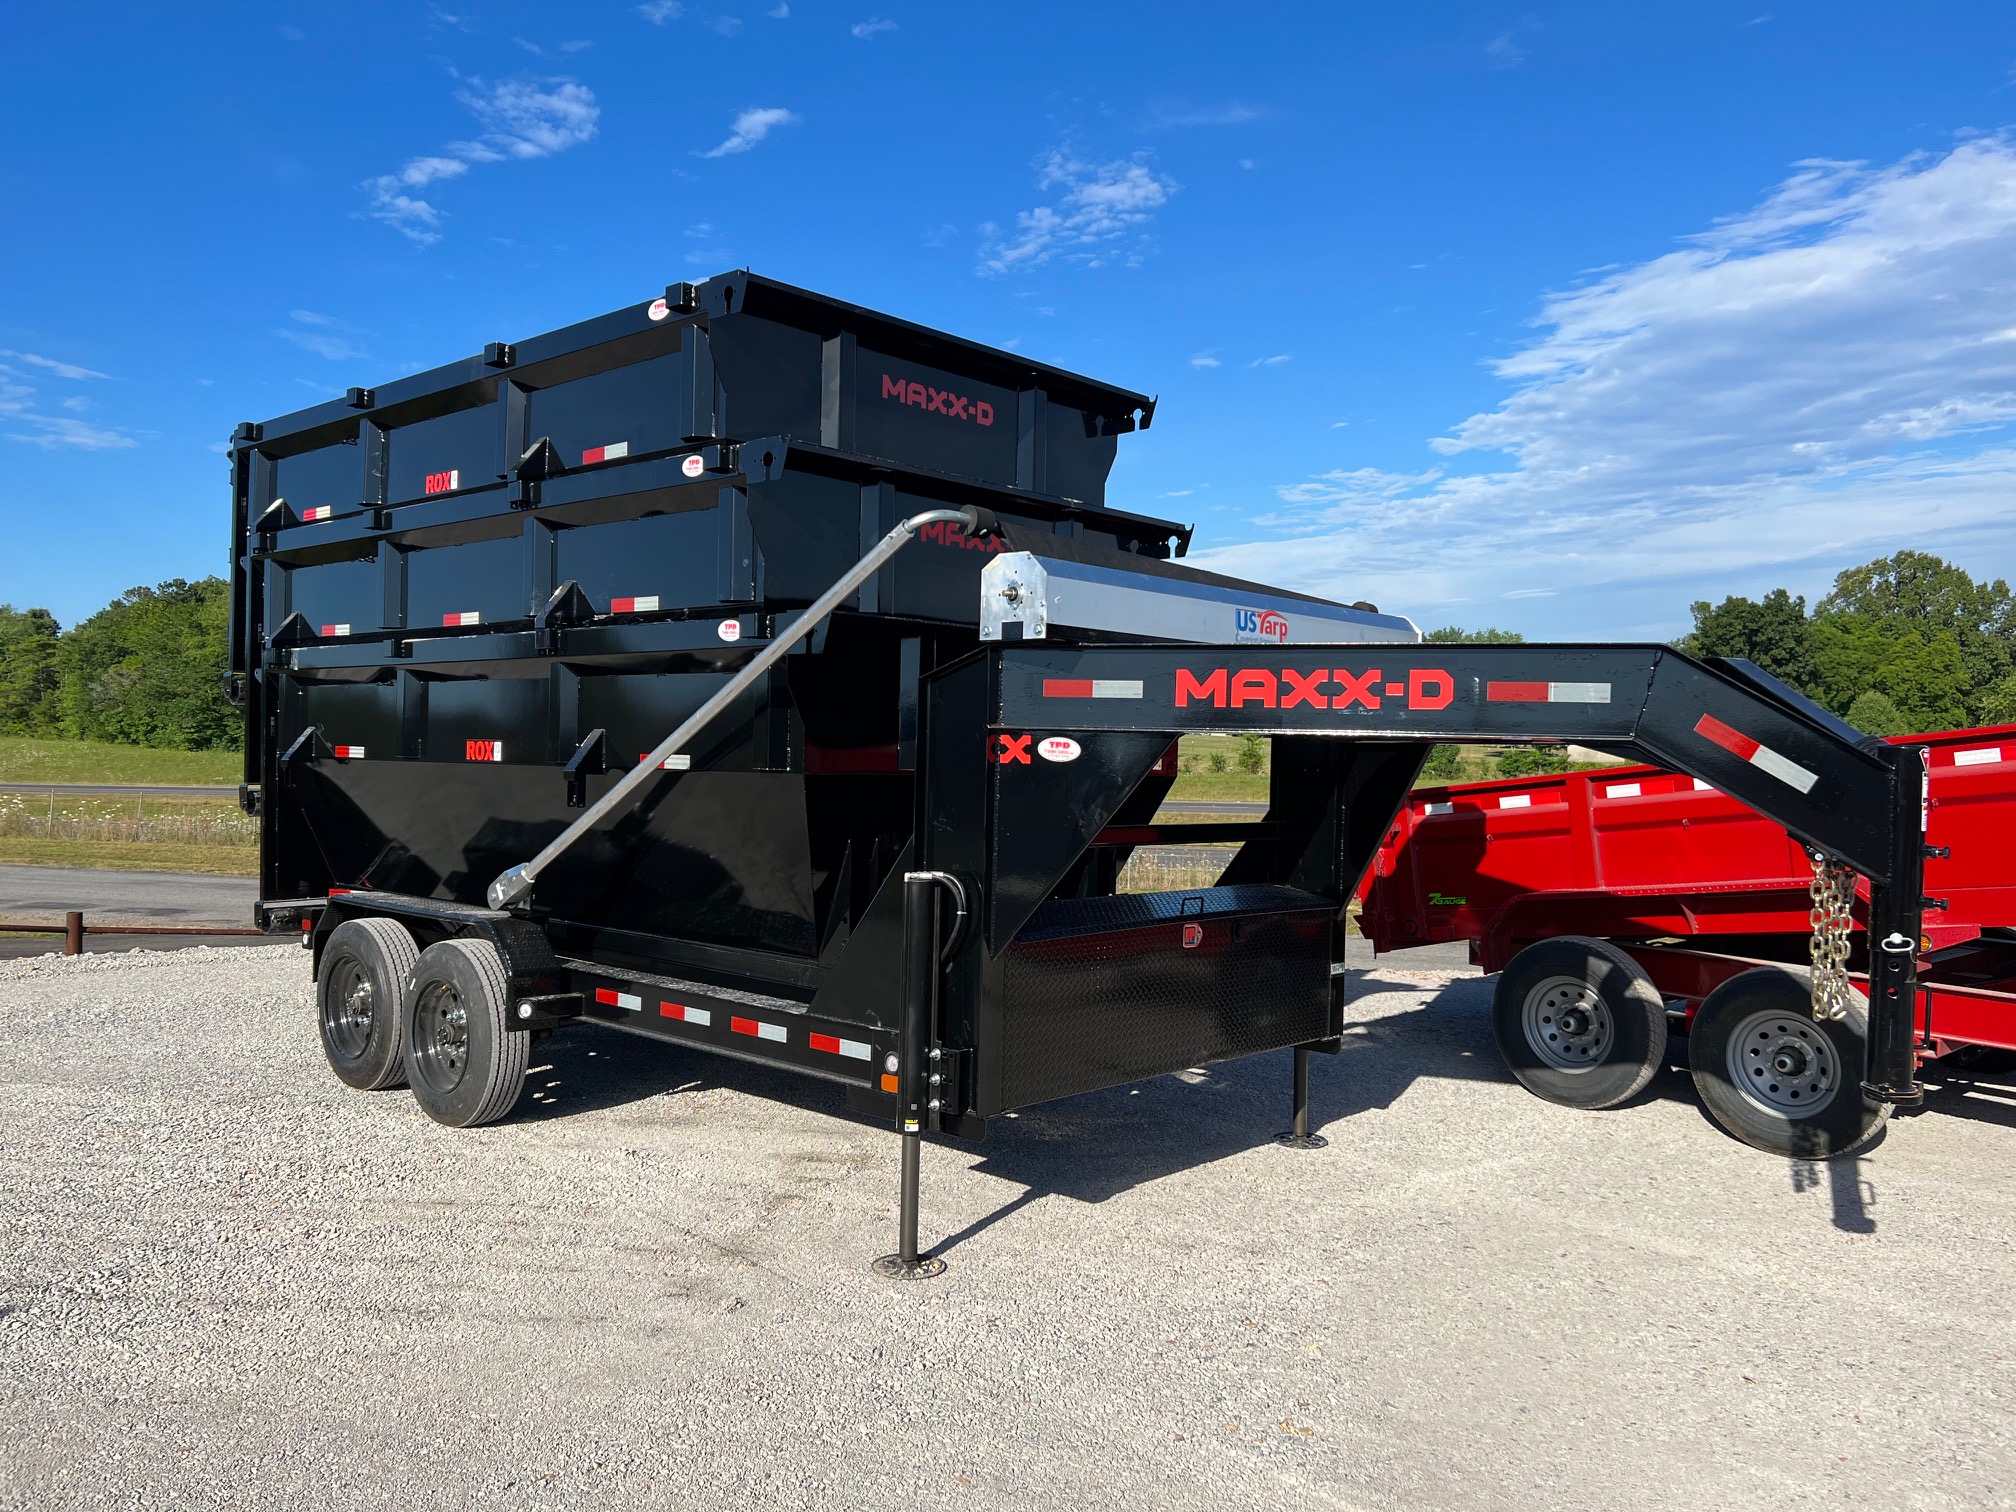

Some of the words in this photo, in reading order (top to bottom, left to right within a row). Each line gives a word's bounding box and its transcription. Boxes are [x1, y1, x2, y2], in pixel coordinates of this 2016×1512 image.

[882, 373, 994, 427] MAXX-D
[425, 471, 451, 495] ROX
[921, 521, 1007, 553] MAXX
[1174, 668, 1454, 710] MAXX-D
[466, 740, 494, 761] ROX
[1049, 741, 1070, 749] TPD
